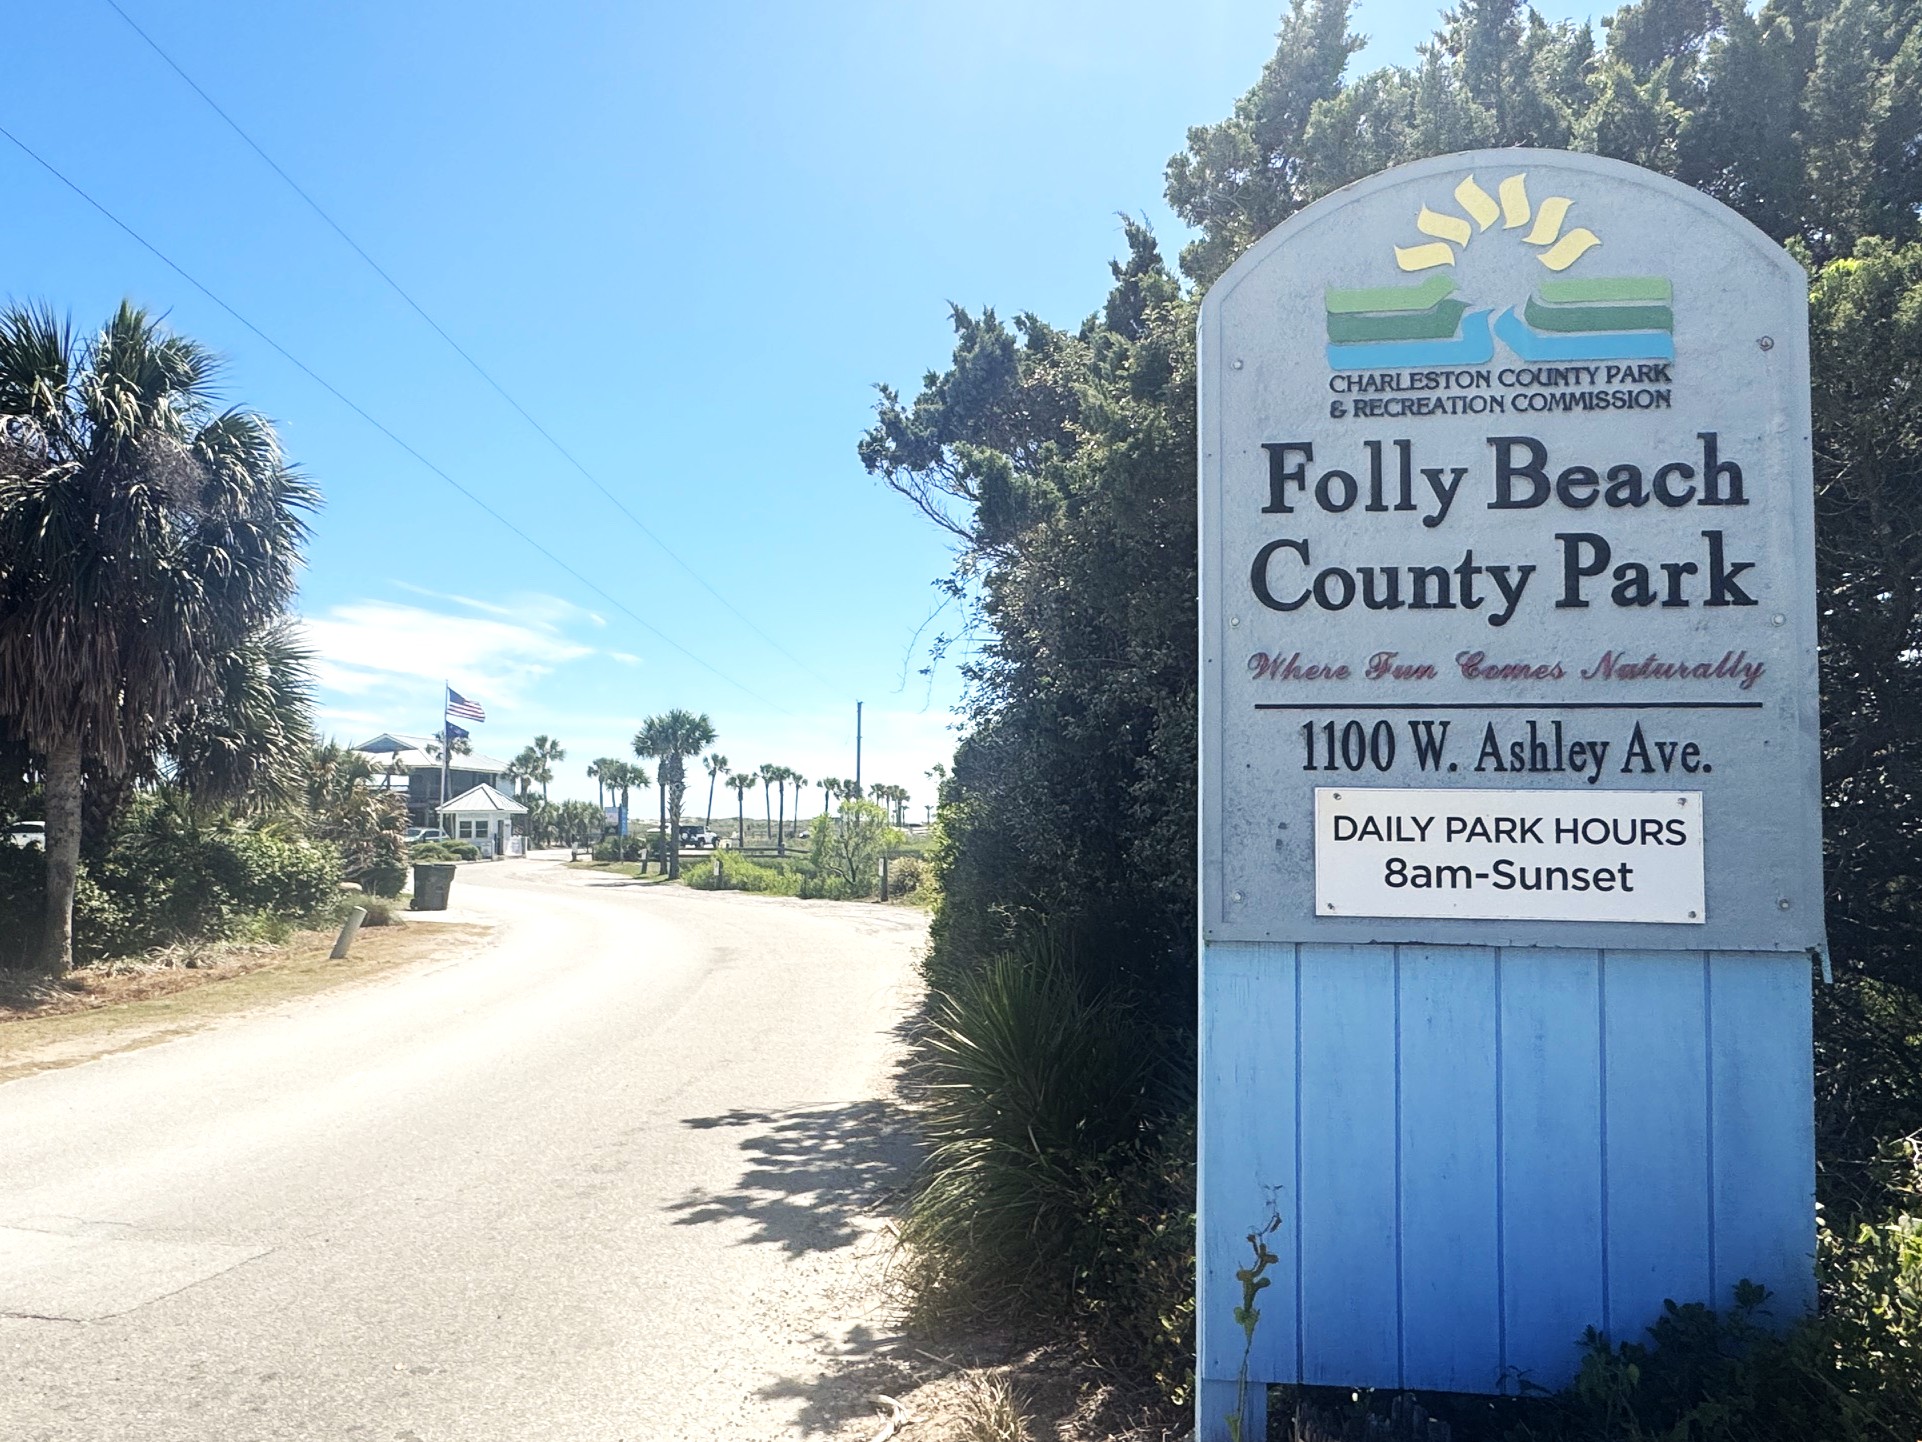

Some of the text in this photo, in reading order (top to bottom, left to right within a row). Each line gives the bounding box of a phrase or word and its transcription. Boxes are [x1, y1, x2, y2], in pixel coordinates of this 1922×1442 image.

[1330, 363, 1672, 394] CHARLESTON COUNTY PARK
[1329, 388, 1672, 419] & RECREATION COMMISSION
[1260, 431, 1750, 528] Folly Beach
[1250, 530, 1759, 627] County Park
[1247, 649, 1766, 689] Where Fun Comes Naturally
[1302, 720, 1712, 784] 1100 W. Ashley Ave.
[1333, 815, 1688, 847] DAILY PARK HOURS
[1384, 857, 1634, 892] 8am-Sunset
